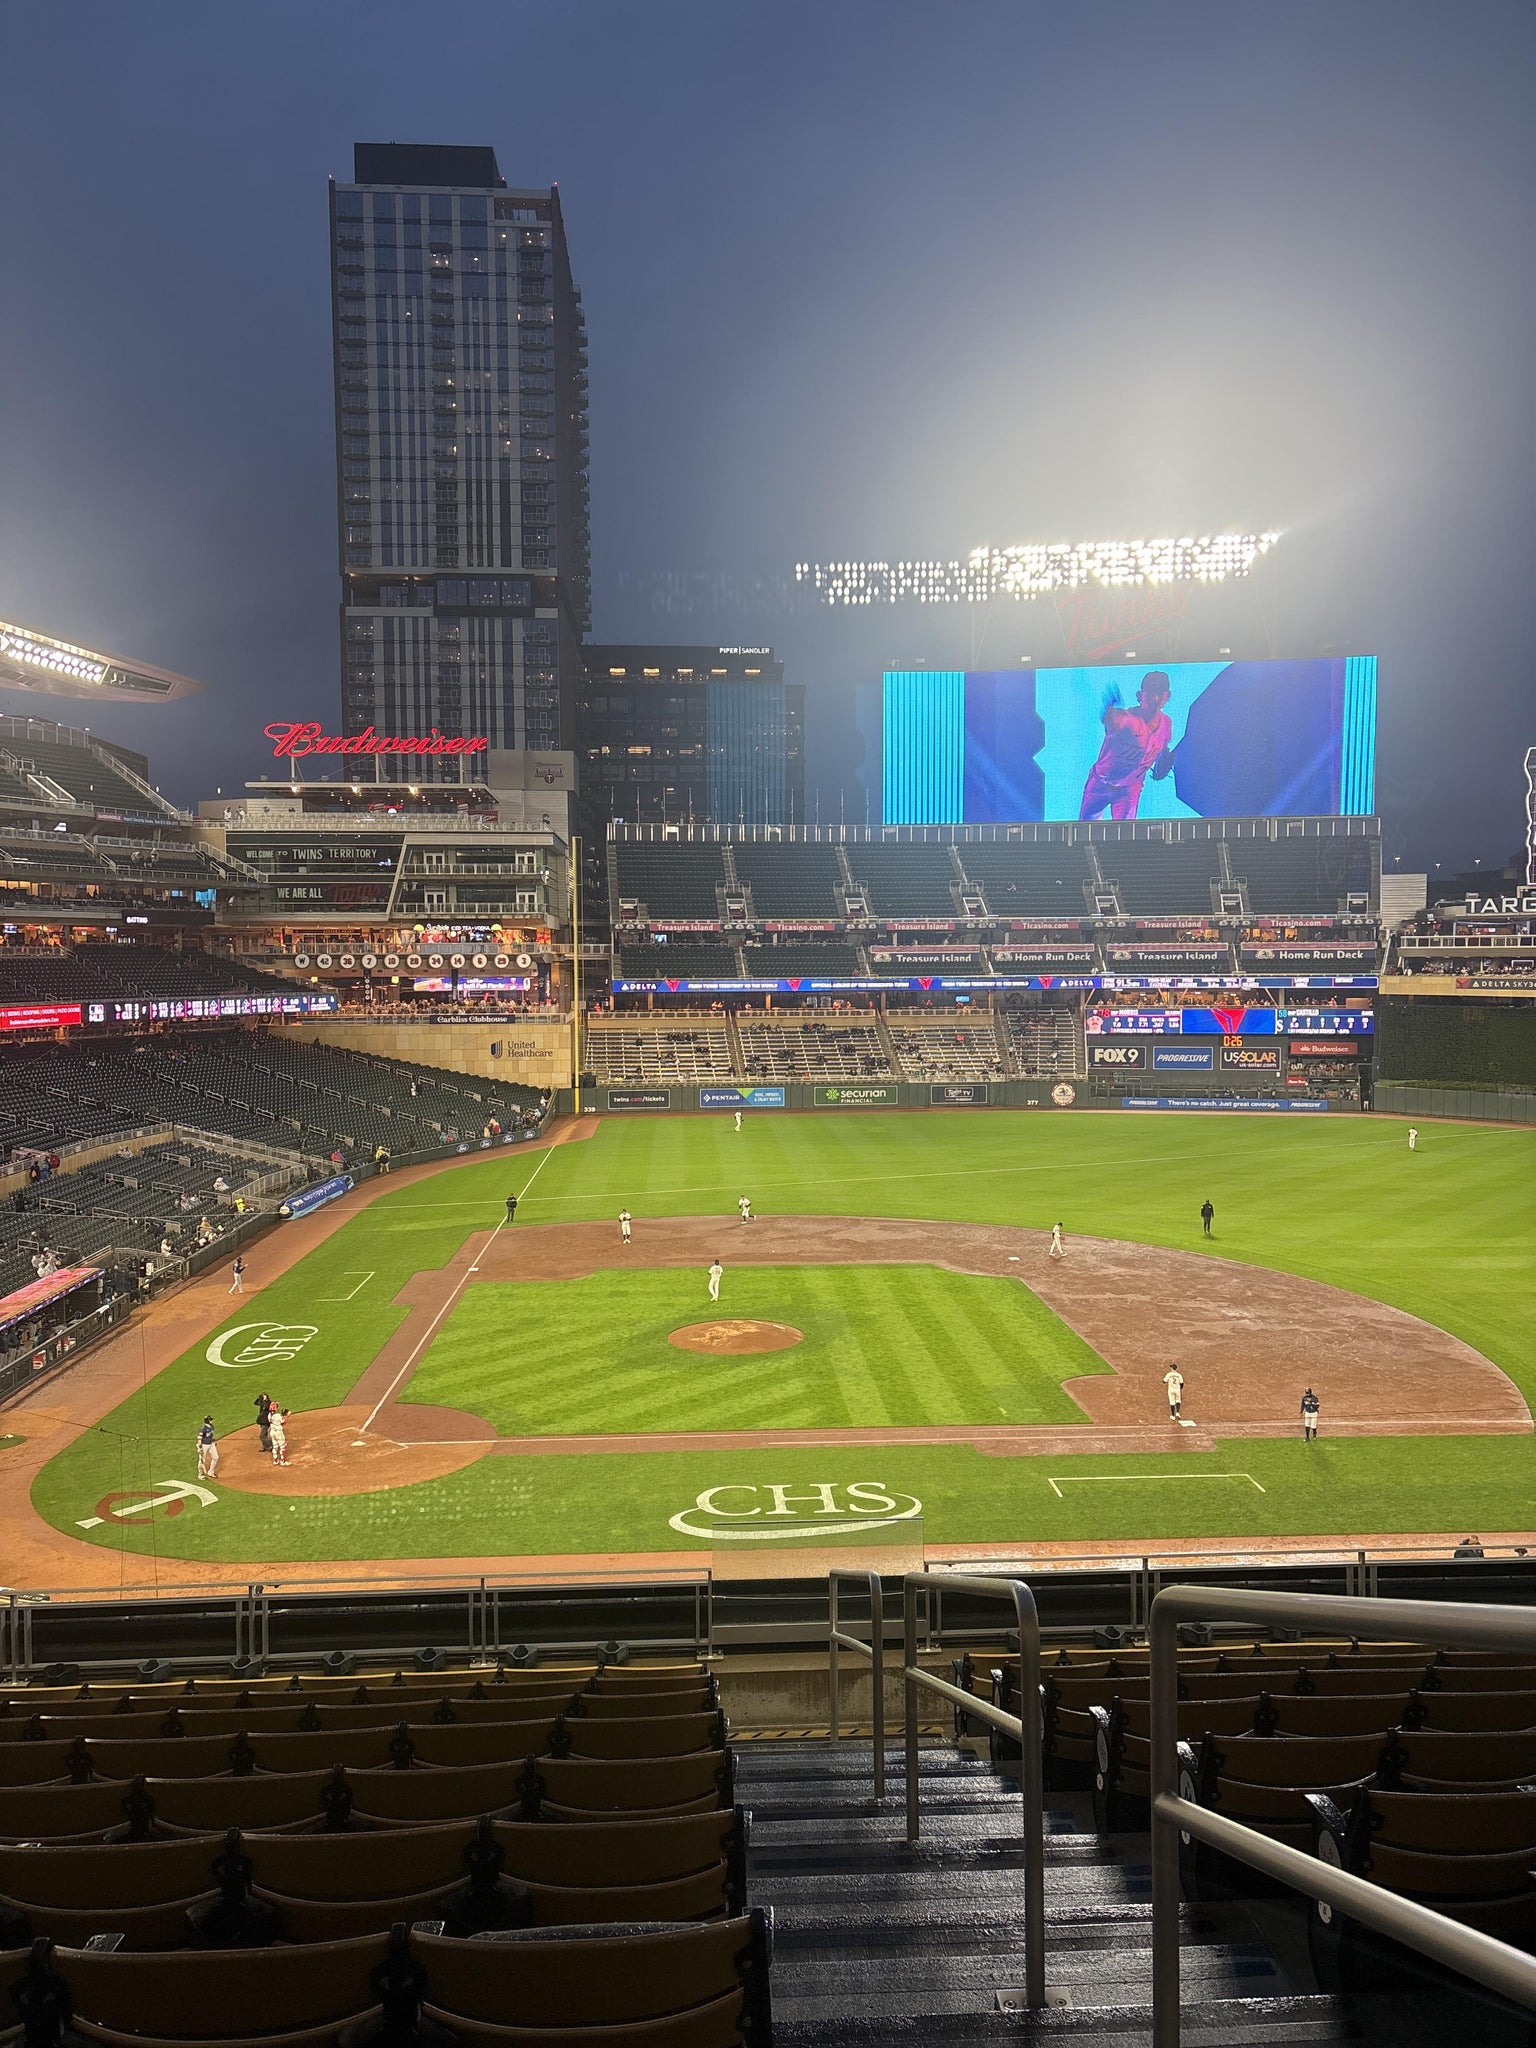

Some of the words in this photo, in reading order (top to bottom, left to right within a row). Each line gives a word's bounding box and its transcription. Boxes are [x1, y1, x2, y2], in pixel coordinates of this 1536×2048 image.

[264, 722, 488, 757] Budweiser
[246, 850, 274, 858] WELCOME
[292, 849, 323, 860] TWINS
[329, 849, 377, 858] TERRITORY
[277, 888, 290, 898] WE
[292, 888, 308, 898] ARE
[309, 888, 323, 898] ALL
[1466, 898, 1536, 914] TARG
[896, 954, 940, 963] Treasure
[941, 954, 972, 962] Island
[1015, 953, 1044, 961] Home
[1045, 953, 1064, 961] Run
[1067, 952, 1091, 961] Deck
[1137, 952, 1183, 961] Treasure
[1185, 951, 1218, 960] Island
[1280, 951, 1311, 959] Home
[1313, 951, 1334, 959] Run
[1337, 950, 1364, 959] Deck
[299, 957, 306, 965] W
[320, 957, 329, 965] 42
[367, 957, 372, 965] 7
[388, 957, 396, 965] 10
[431, 957, 441, 965] 34
[453, 957, 462, 965] 14
[477, 957, 483, 965] 6
[521, 957, 527, 965] 3
[468, 1015, 508, 1023] Clubhouse
[507, 1041, 535, 1049] United
[1223, 1035, 1243, 1047] 0:26
[508, 1049, 553, 1058] Healthcare
[1094, 1048, 1127, 1063] FOX
[1127, 1048, 1139, 1063] 9
[1157, 1054, 1210, 1062] PROGRESSIVE
[840, 1089, 887, 1098] securian
[1172, 1377, 1177, 1385] 2
[696, 1482, 896, 1516] CHS
